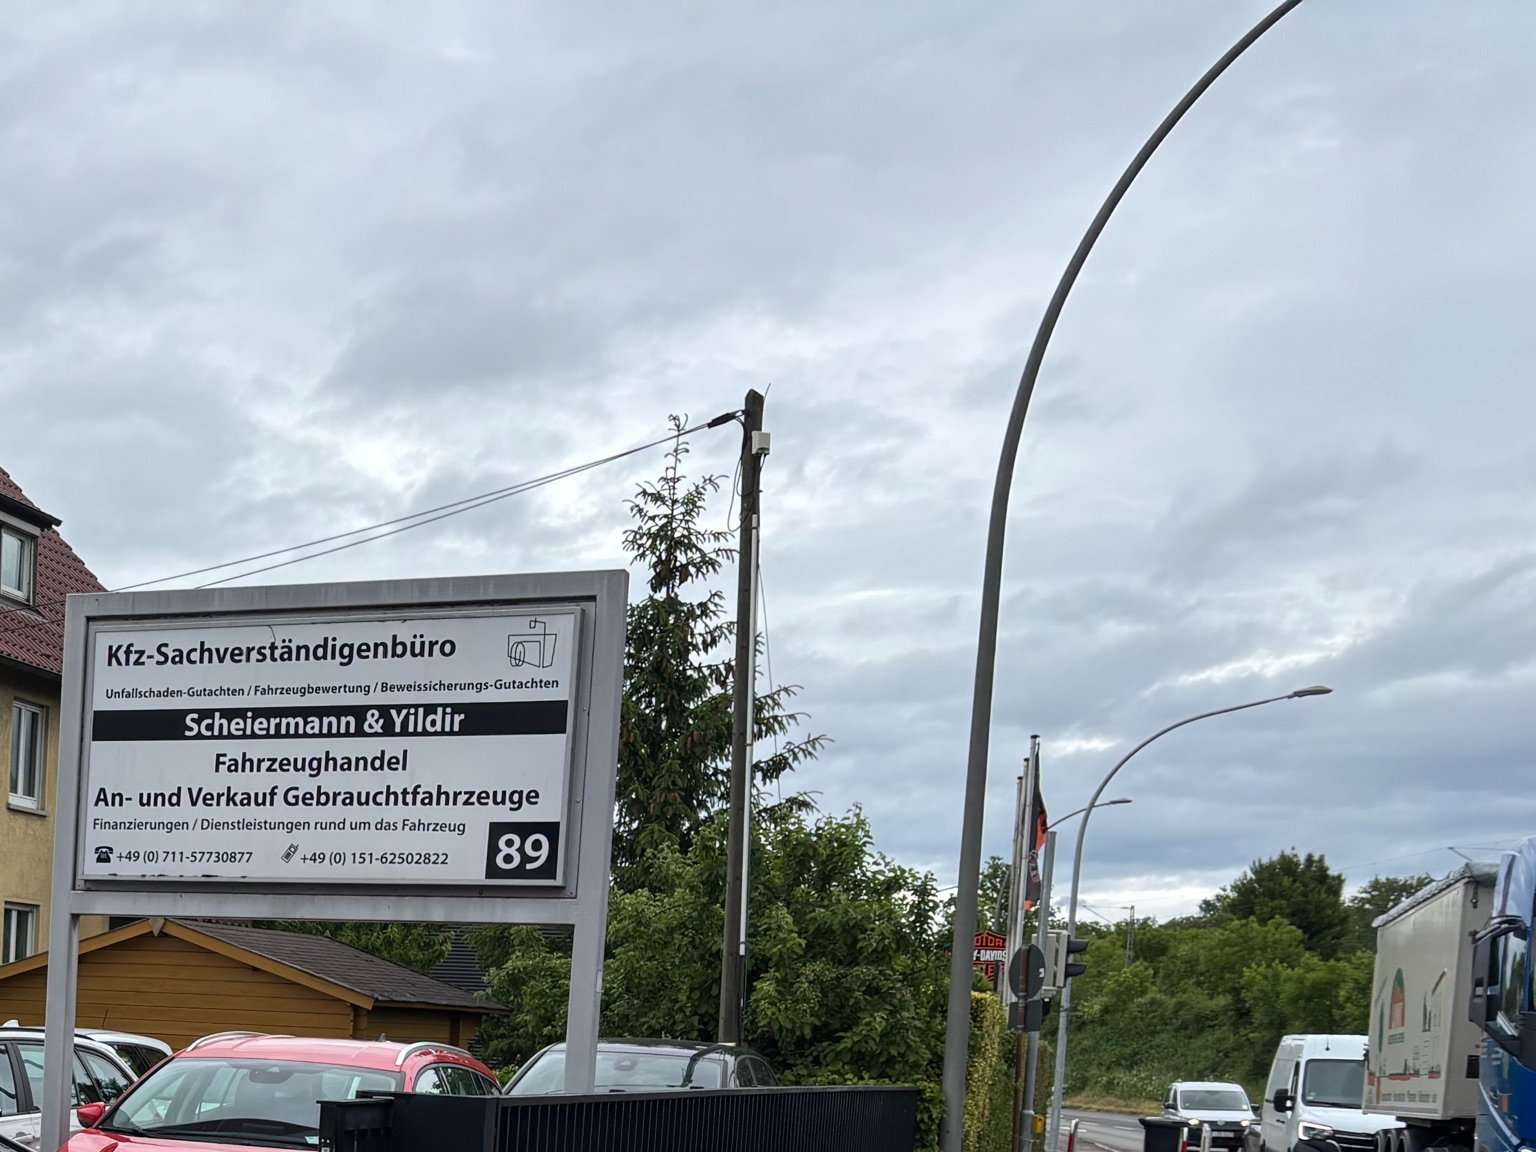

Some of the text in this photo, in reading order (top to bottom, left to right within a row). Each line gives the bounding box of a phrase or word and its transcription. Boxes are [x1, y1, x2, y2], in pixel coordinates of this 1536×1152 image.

[107, 634, 457, 666] Kfz-Sachverständigenbüro
[106, 685, 245, 699] Unfallschaden-Gutachten
[254, 682, 371, 697] Fahrzeugbewertung
[380, 678, 559, 693] Beweissicherungs-Gutachten
[184, 707, 465, 736] Scheiermann & Yildir
[214, 749, 408, 777] Fahrzeughandel
[94, 784, 540, 811] An- und Verkauf Gebrauchtfahrzeuge
[93, 818, 189, 833] Finanzierungen
[201, 818, 311, 833] Dienstleistungen
[314, 818, 346, 831] rund
[350, 821, 371, 831] um
[375, 818, 398, 832] das
[402, 818, 466, 835] Fahrzeug
[117, 850, 253, 865] +49 (0) 711-57730877
[300, 851, 449, 866] +49 (0) 151-62502822
[495, 833, 550, 870] 89
[975, 935, 1004, 946] OTOR
